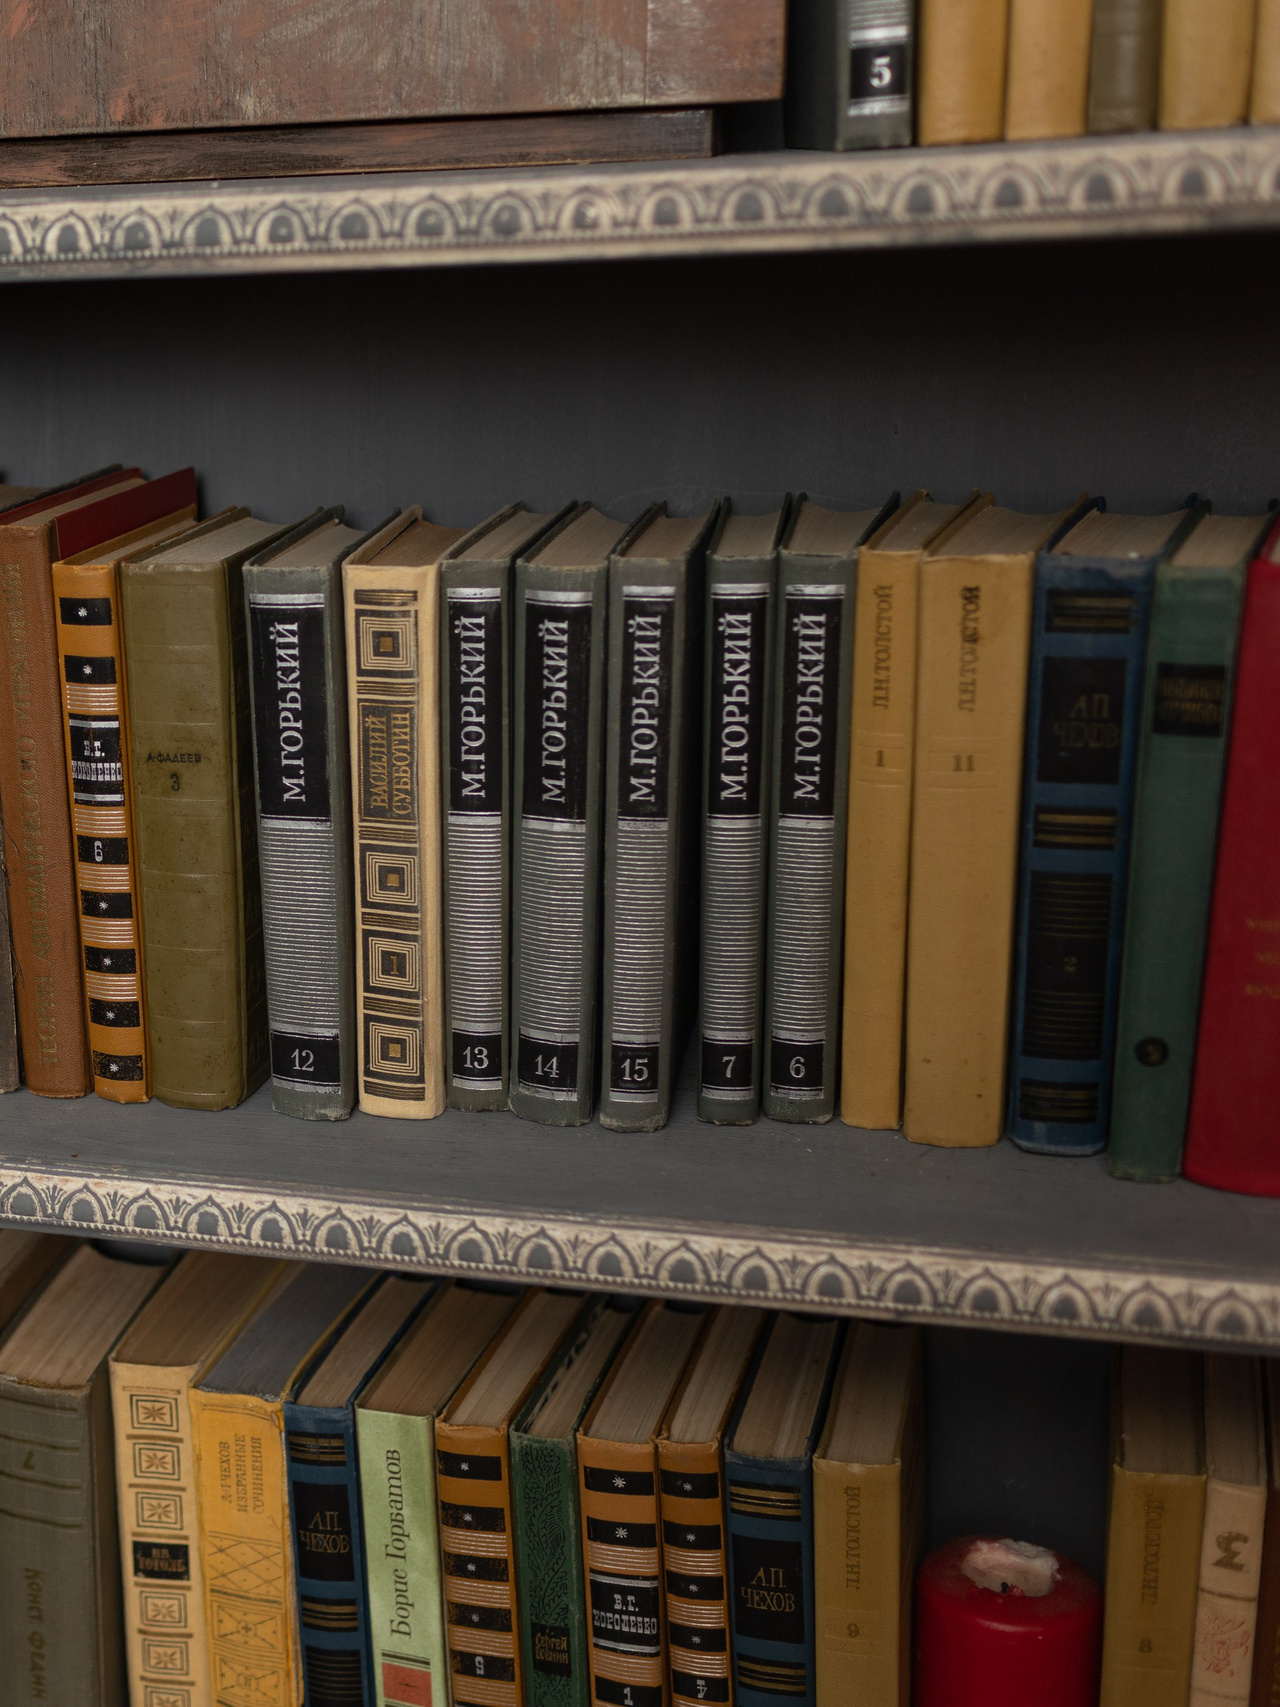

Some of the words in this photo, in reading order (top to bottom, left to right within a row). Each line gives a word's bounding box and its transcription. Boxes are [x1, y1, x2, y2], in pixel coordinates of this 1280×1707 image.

[868, 55, 893, 89] 5
[71, 760, 123, 782] КОРОЛЕНКО
[364, 715, 389, 810] ВАСИЛИЙ
[392, 712, 412, 816] СУББОТИН
[952, 755, 975, 773] 11
[170, 773, 181, 792] 3
[94, 840, 104, 863] 6
[290, 1048, 315, 1073] 12
[462, 1046, 489, 1070] 13
[533, 1054, 560, 1079] 14
[620, 1058, 649, 1082] 15
[721, 1055, 737, 1079] 7
[789, 1056, 806, 1079] 6
[234, 1434, 248, 1513] ИЗБРАННЫЕ
[250, 1436, 265, 1515] СОЧИНЕНИЯ
[298, 1529, 350, 1554] ЧЕХОВ
[390, 1568, 415, 1640] Борис
[613, 1594, 639, 1612] В.Г.
[740, 1586, 796, 1613] ЧЕХОВ
[593, 1609, 658, 1635] КОРОЛЕНКО
[623, 1687, 634, 1706] 1
[696, 1679, 708, 1699] 4
